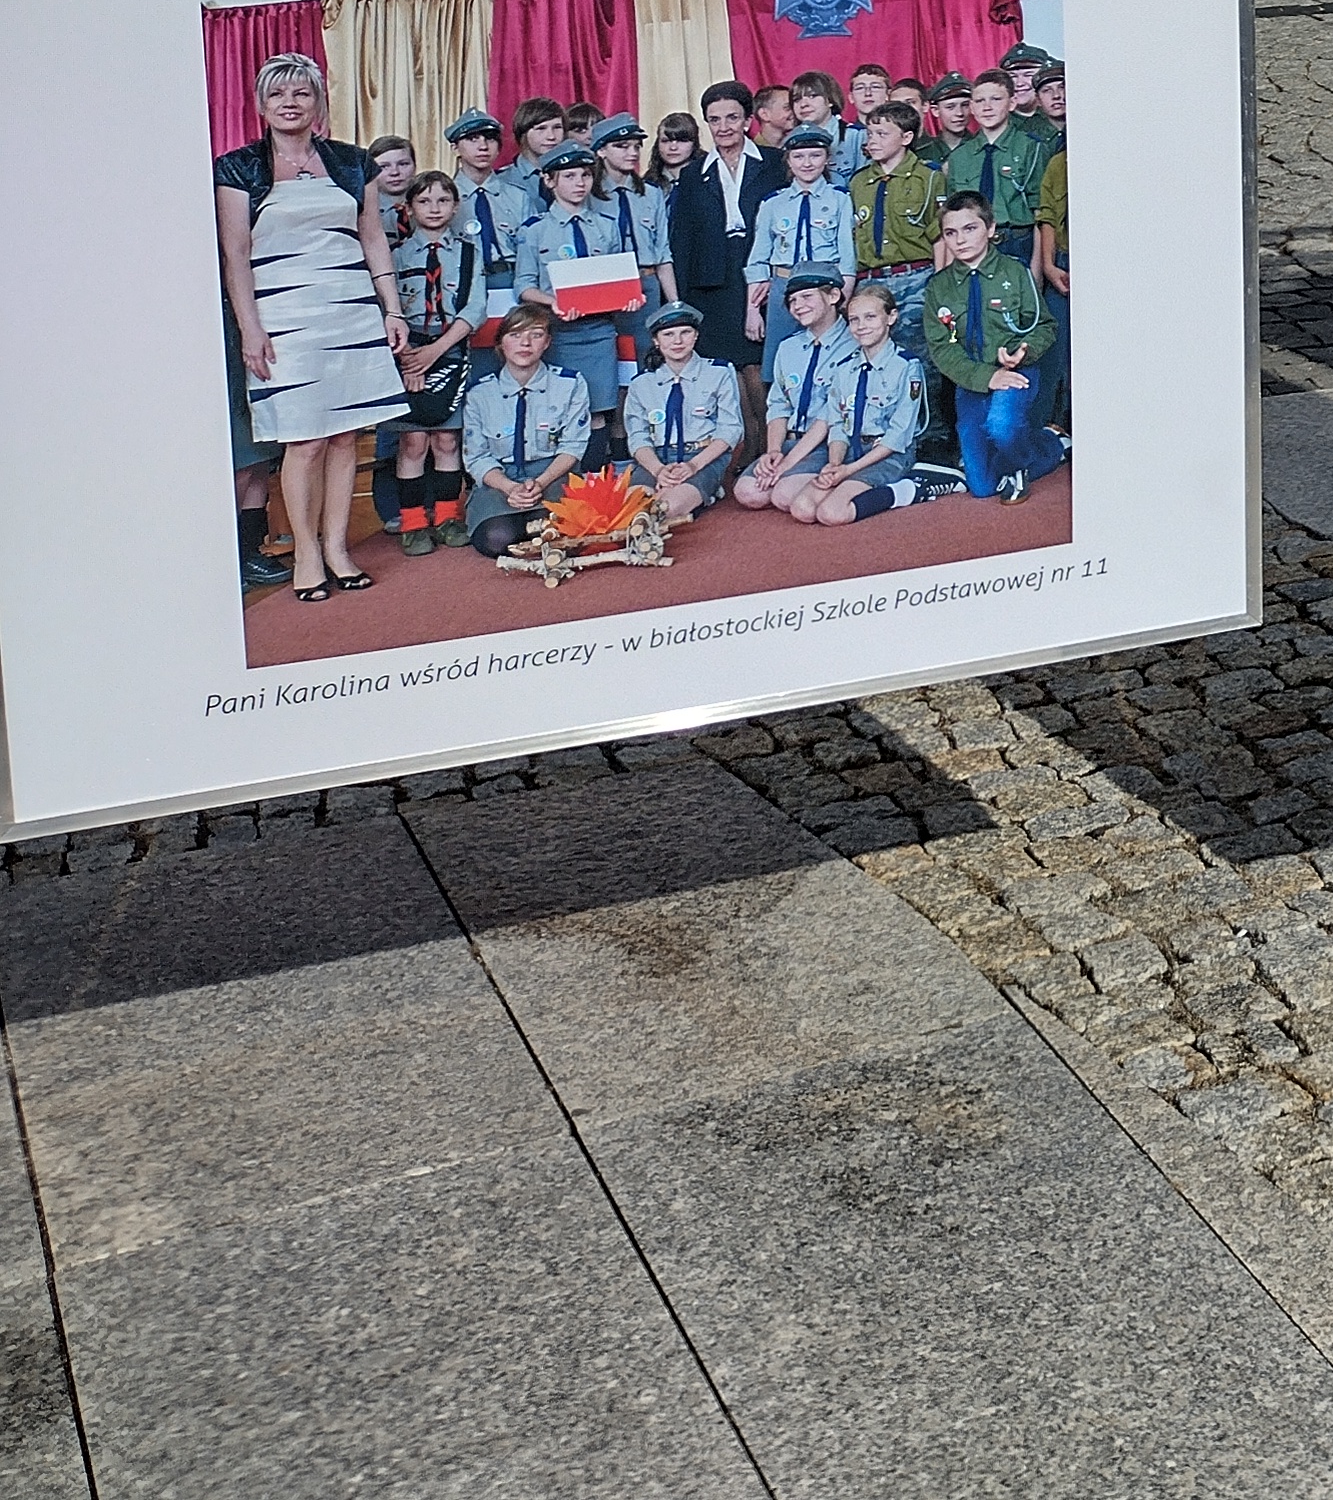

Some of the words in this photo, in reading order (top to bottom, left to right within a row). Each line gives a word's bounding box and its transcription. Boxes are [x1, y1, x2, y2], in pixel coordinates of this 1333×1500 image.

[205, 688, 265, 717] Pani
[276, 675, 390, 707] Karolina
[400, 656, 480, 687] wśród
[488, 643, 597, 674] harcerzy
[622, 636, 643, 652] w
[650, 605, 805, 649] białostockiej
[811, 594, 887, 623] Szkole
[894, 566, 1044, 609] Podstawowej
[1051, 566, 1075, 583] nr
[1082, 558, 1108, 578] 11
